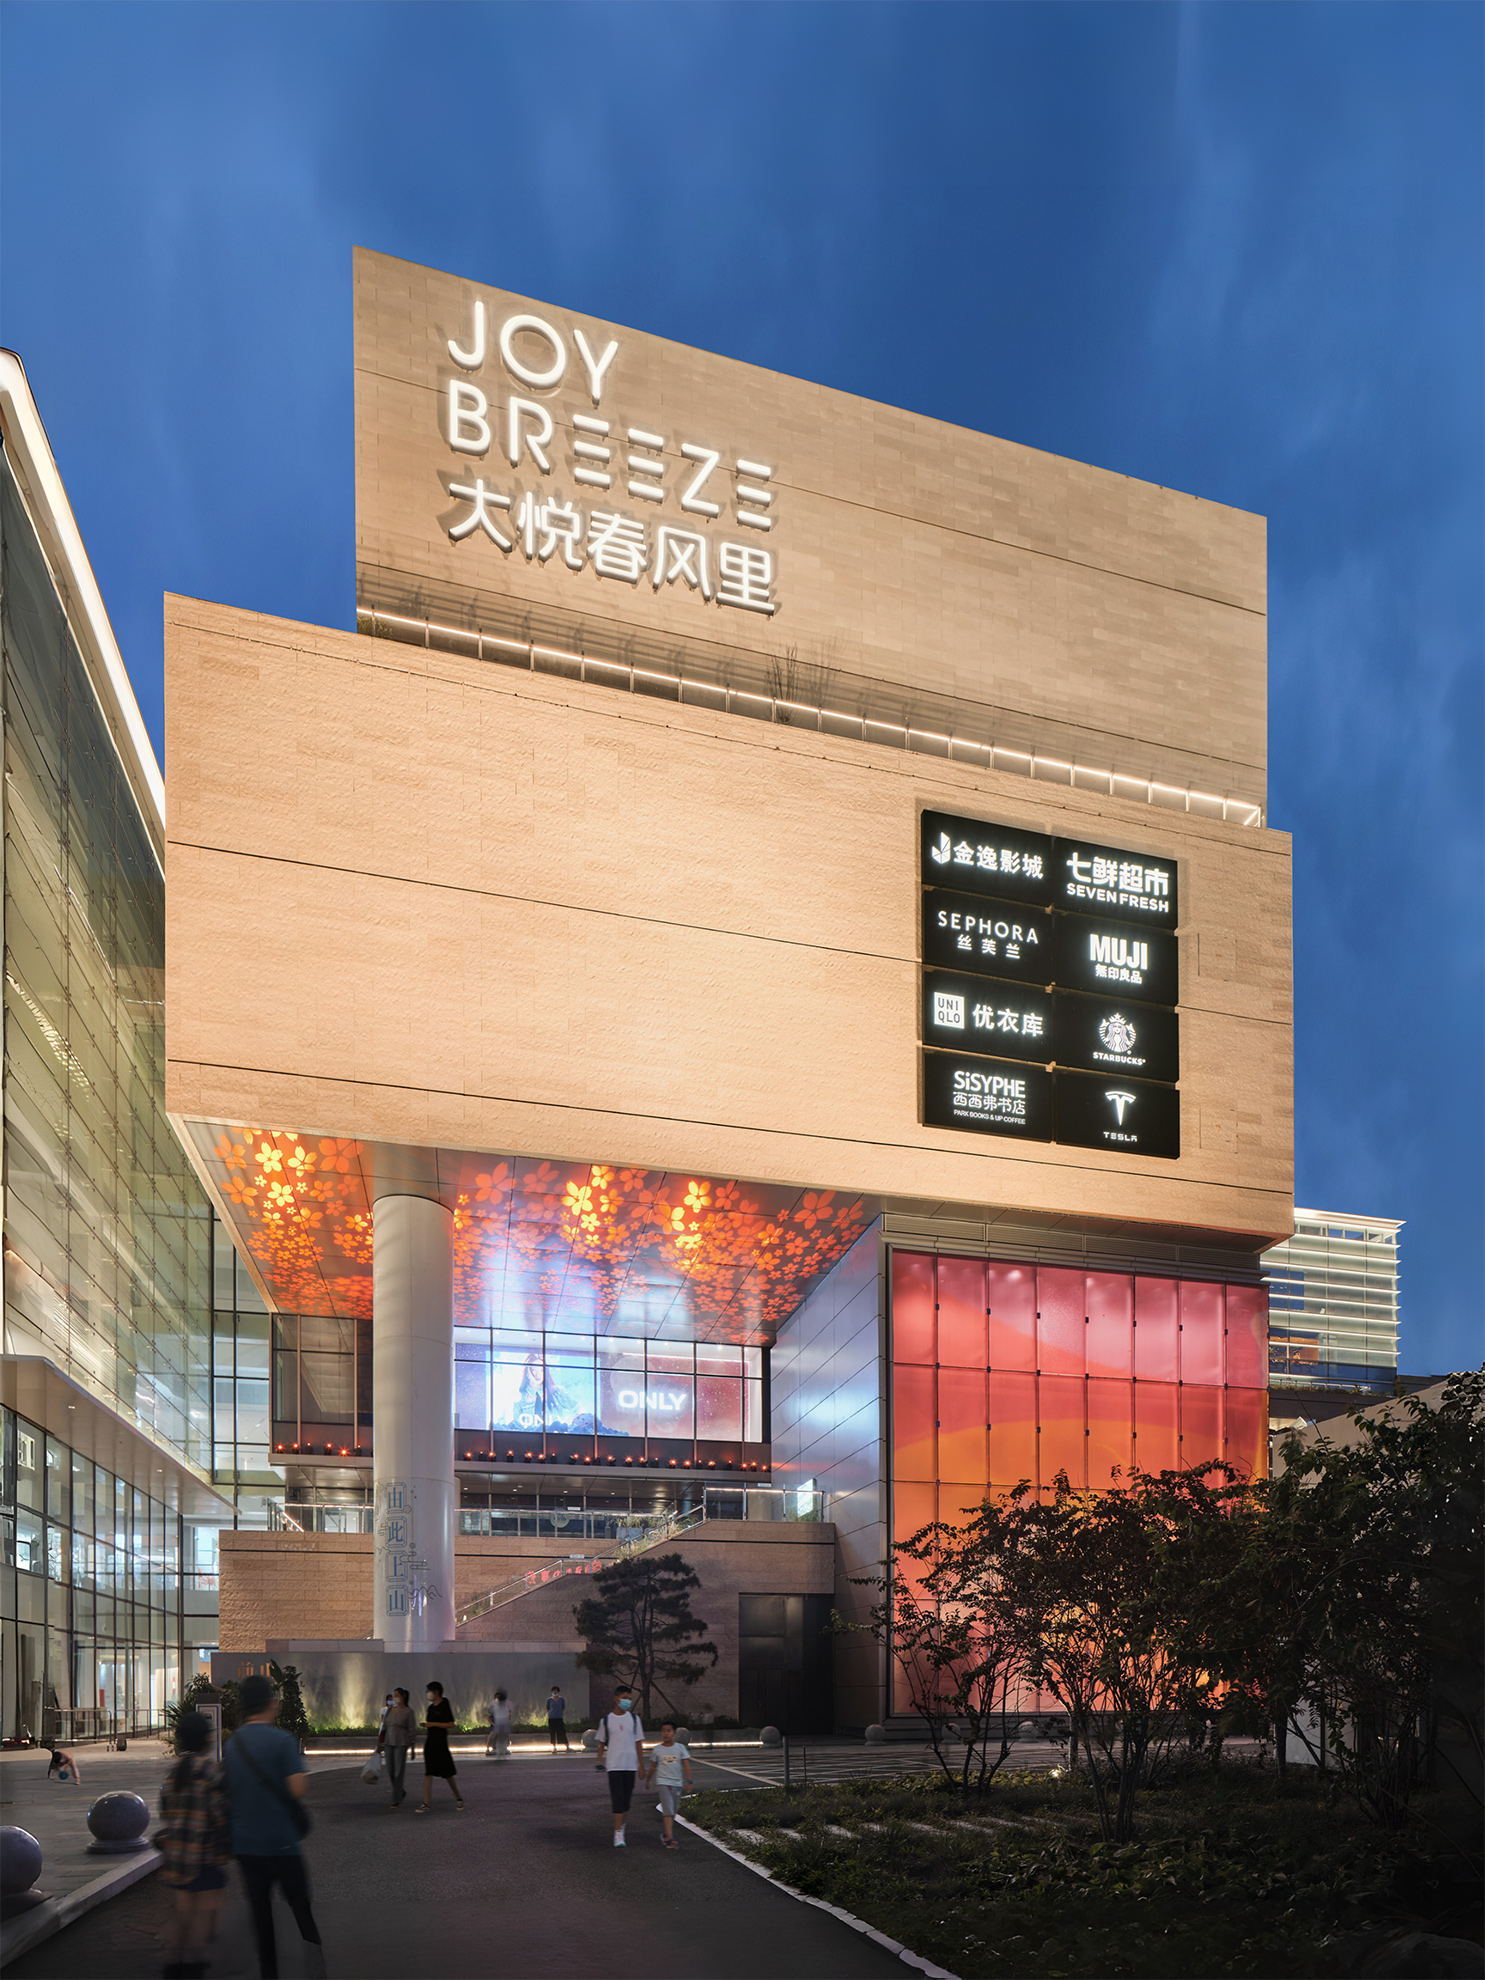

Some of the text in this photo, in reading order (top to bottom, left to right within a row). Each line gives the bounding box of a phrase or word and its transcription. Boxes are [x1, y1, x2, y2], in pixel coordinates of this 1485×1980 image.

[447, 300, 619, 405] JOY
[448, 379, 772, 532] BREEZE
[448, 478, 775, 616] 大悦春风里
[953, 840, 1044, 880] 金逸影城
[1066, 852, 1169, 896] 七鲜超市
[1066, 882, 1169, 913] SEVEN FRESH
[938, 910, 1039, 945] SEPHORA
[957, 933, 1020, 960] 丝芙兰
[1089, 933, 1148, 970] MUJI
[1095, 963, 1143, 985] 無印良品
[938, 997, 959, 1011] UNI
[938, 1010, 960, 1024] QLO
[972, 1003, 1044, 1037] 优衣库
[1092, 1051, 1143, 1066] STARBUCKS
[953, 1091, 1026, 1115] 西西弗书店
[953, 1108, 969, 1118] PARK
[969, 1111, 990, 1121] BOOKS
[995, 1114, 1003, 1122] UP
[1003, 1116, 1026, 1125] COFFEE
[1103, 1131, 1138, 1143] TESLA
[618, 1390, 687, 1411] ONLY
